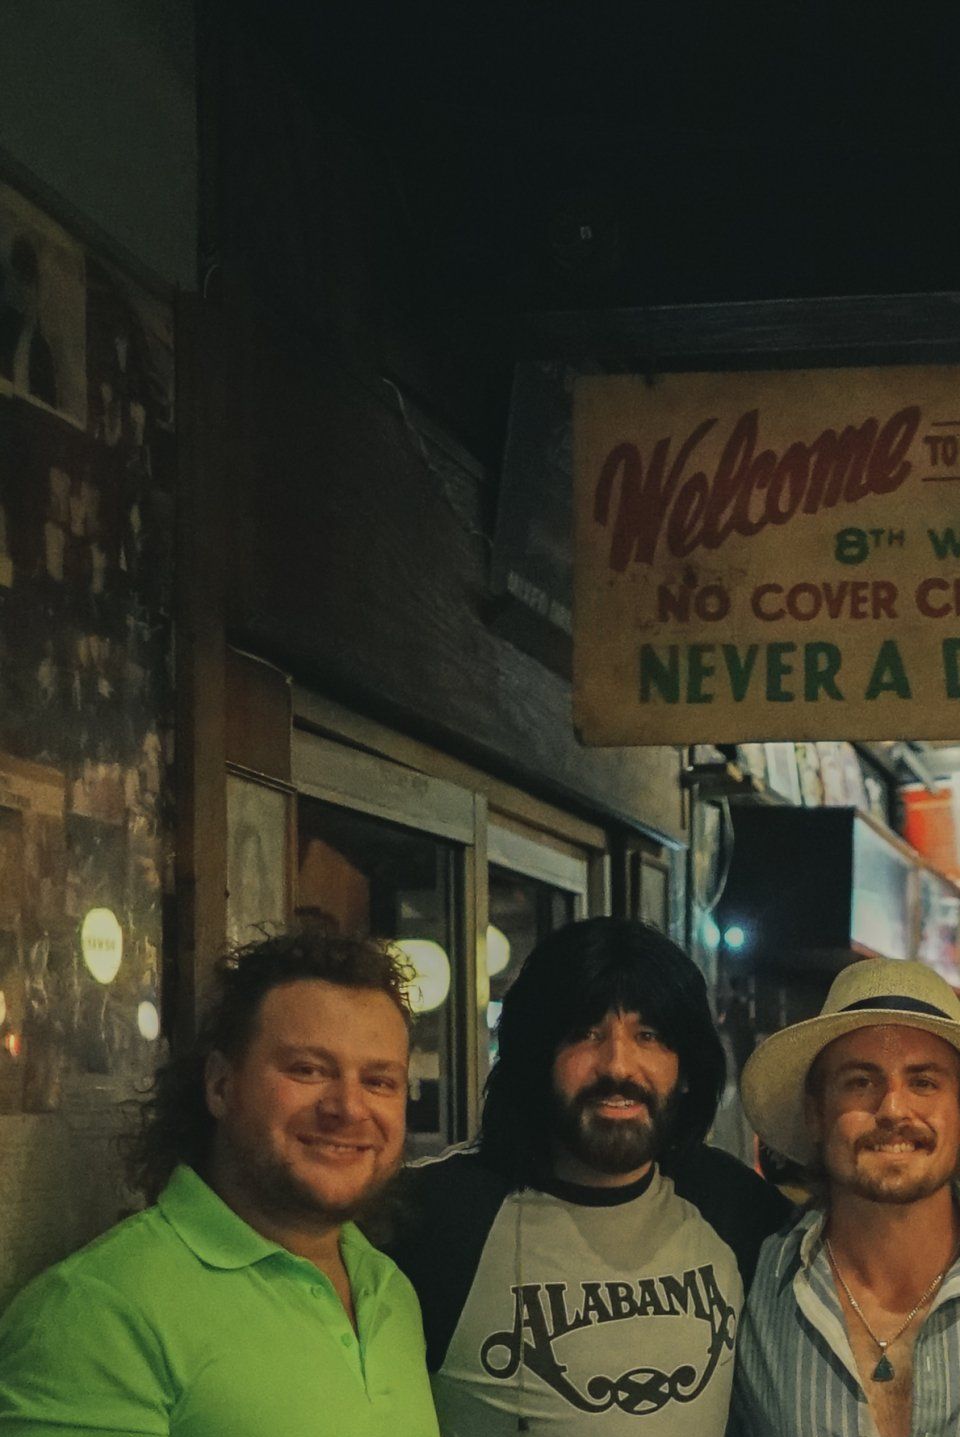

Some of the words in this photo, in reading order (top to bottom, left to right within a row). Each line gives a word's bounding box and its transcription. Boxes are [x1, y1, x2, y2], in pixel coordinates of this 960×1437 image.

[594, 405, 922, 573] Welcome
[925, 435, 958, 468] TO
[833, 526, 906, 566] 8TH
[657, 584, 731, 624] NO
[751, 580, 899, 622] COVER
[638, 640, 845, 705] NEVER
[864, 639, 913, 700] A
[481, 1264, 737, 1380] ALABAMA
